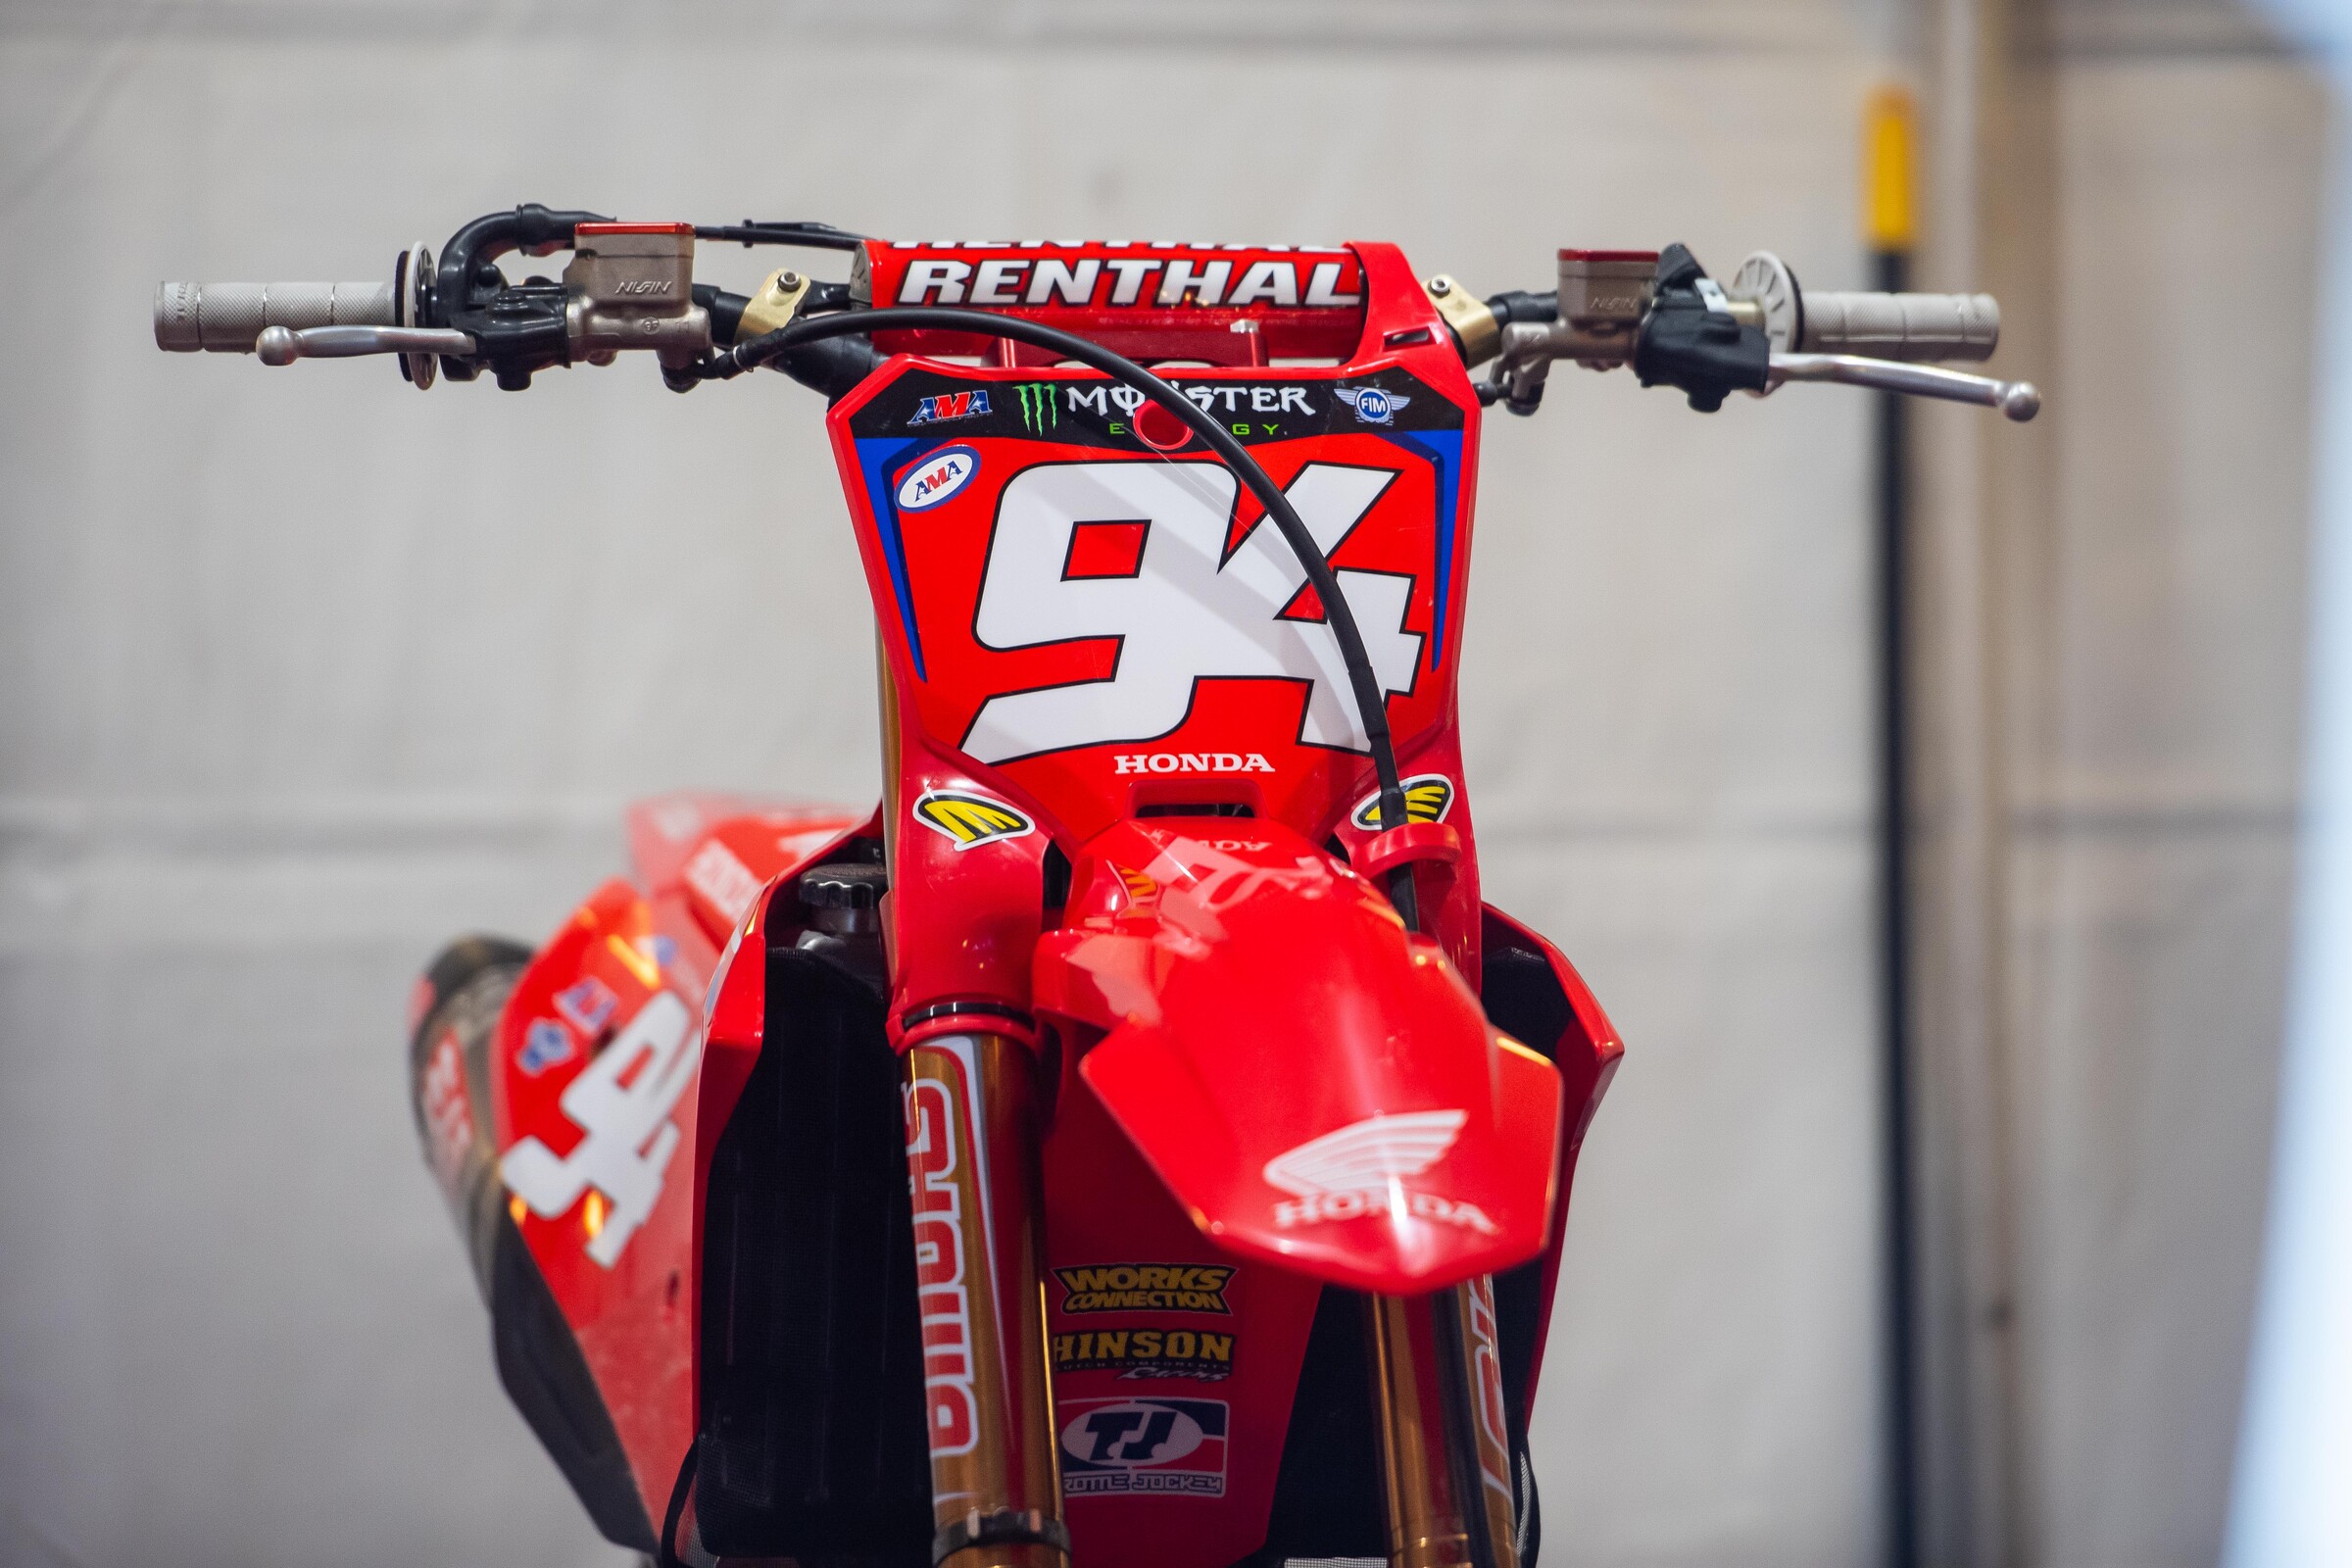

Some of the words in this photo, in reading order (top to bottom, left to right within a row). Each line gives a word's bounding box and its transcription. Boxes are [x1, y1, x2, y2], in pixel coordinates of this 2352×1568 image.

[615, 281, 671, 294] NISSIN
[897, 259, 1360, 306] RENTHAL
[906, 390, 993, 425] AMA
[1066, 380, 1316, 416] MOSTER
[1361, 397, 1387, 414] FIM
[1109, 423, 1279, 435] EGY
[914, 460, 962, 502] AMA
[958, 461, 1427, 768] 94
[1114, 753, 1276, 774] HONDA
[1061, 1266, 1230, 1292] WORKS
[1065, 1291, 1224, 1310] CONNECTION
[1054, 1331, 1233, 1361] HINSON
[1085, 1411, 1178, 1461] TJ
[1132, 1473, 1223, 1494] JOCKEY
